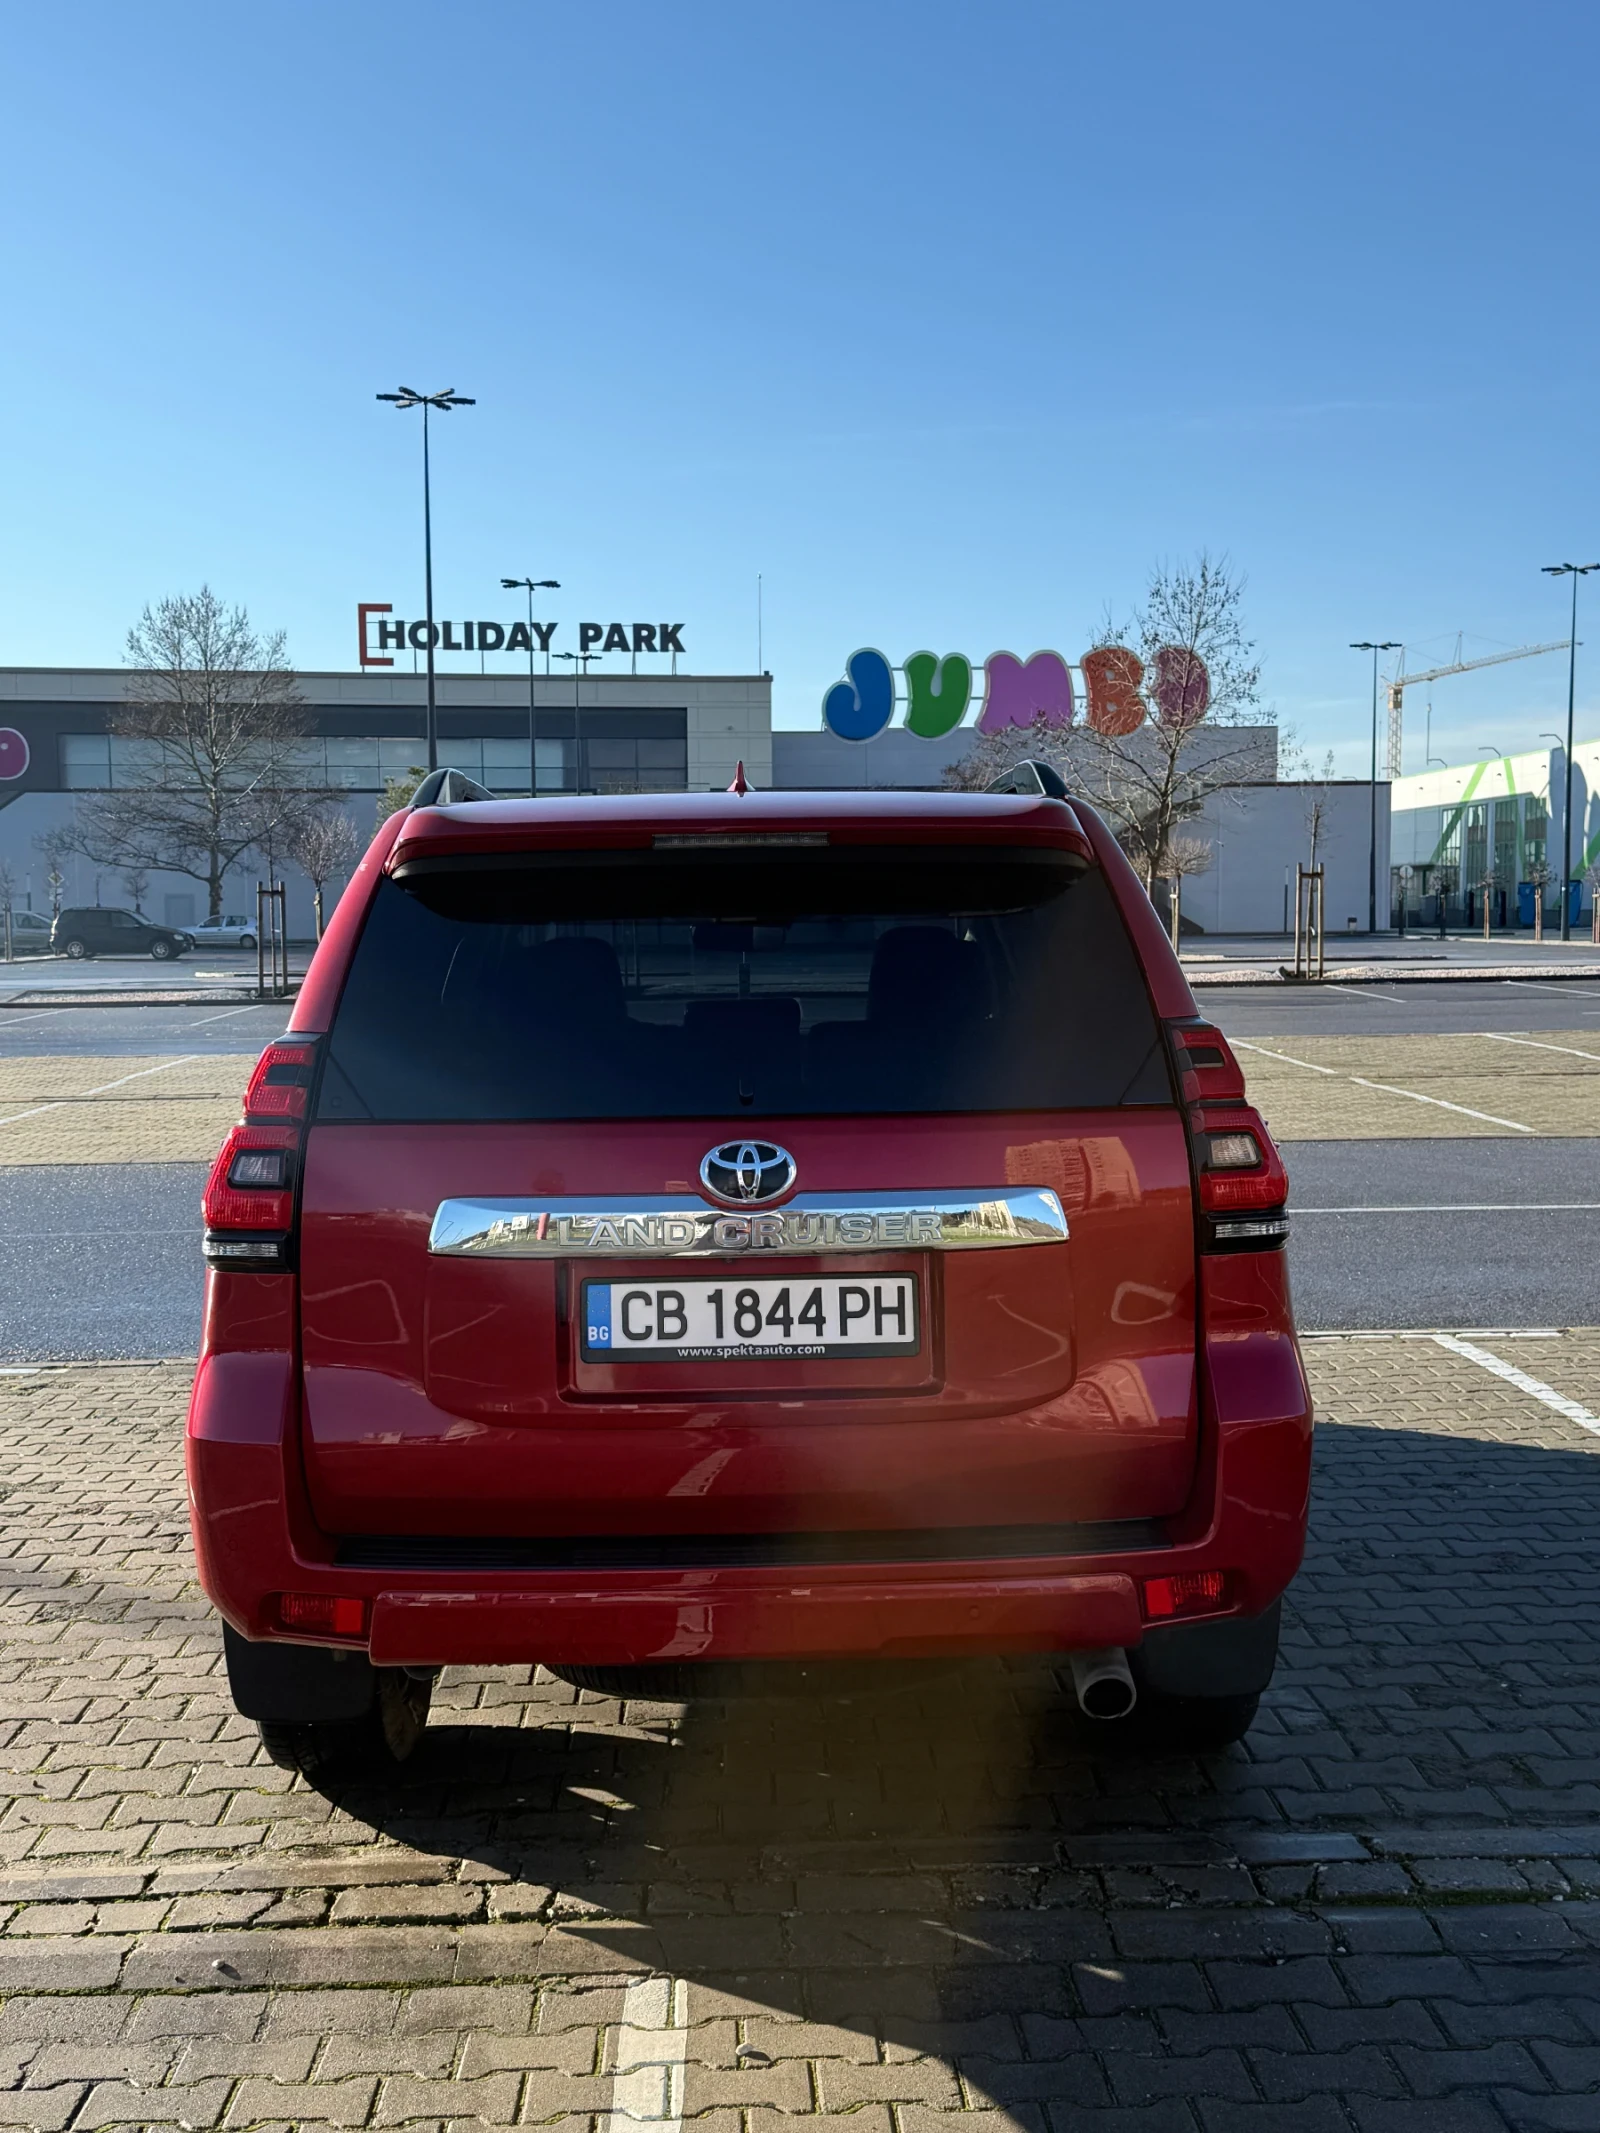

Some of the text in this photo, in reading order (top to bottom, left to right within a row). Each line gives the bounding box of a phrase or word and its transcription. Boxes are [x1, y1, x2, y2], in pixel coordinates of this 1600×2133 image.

[379, 620, 686, 652] HOLIDAY PARK
[822, 647, 1211, 743] JUMBO
[557, 1212, 944, 1249] LAND CRUISER
[621, 1285, 906, 1341] CB 1844 PH
[588, 1326, 609, 1341] BG
[677, 1343, 826, 1358] www.spektaauto.com
